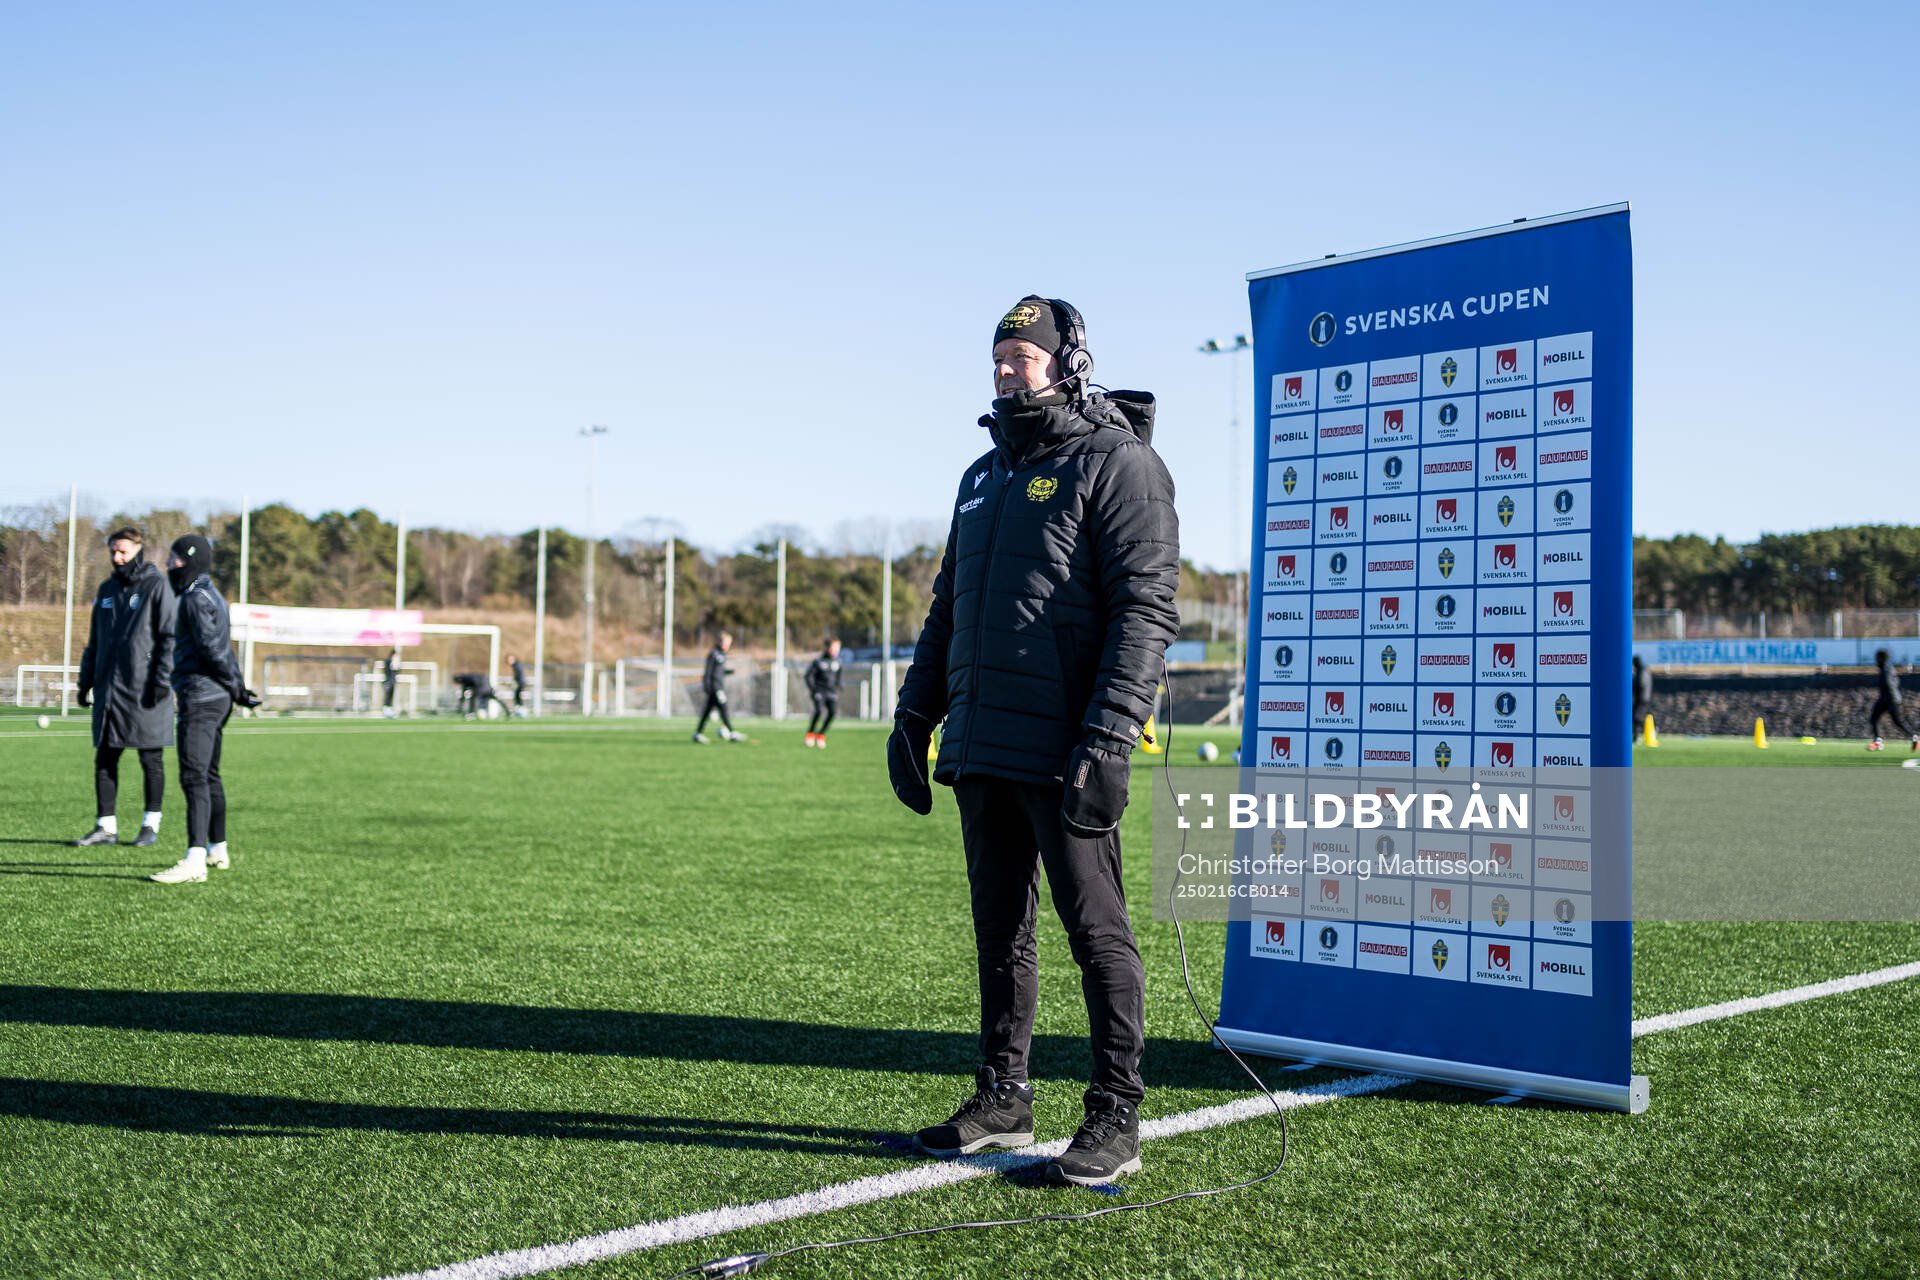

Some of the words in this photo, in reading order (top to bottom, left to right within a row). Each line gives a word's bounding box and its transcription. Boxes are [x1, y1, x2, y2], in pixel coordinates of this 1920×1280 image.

[1345, 300, 1455, 336] SVENSKA
[1462, 285, 1550, 318] CUPEN
[1544, 351, 1584, 366] MOBILL
[1372, 372, 1417, 386] BAUHAUS
[1486, 376, 1512, 384] SVENSKA
[1486, 409, 1527, 423] MOBILL
[1275, 431, 1308, 443] MOBILL
[1320, 425, 1363, 438] BAUHAUS
[1540, 450, 1588, 464] BAUHAUS
[1424, 461, 1472, 474] BAUHAUS
[1323, 471, 1358, 483] MOBILL
[1374, 513, 1411, 525] MOBILL
[1268, 520, 1309, 531] BAUHAUS
[1544, 552, 1583, 564] MOBILL
[1368, 560, 1413, 572] BAUHAUS
[1268, 612, 1303, 621] MOBILL
[1315, 609, 1359, 620] BAUHAUS
[1484, 606, 1526, 618] MOBILL
[1318, 656, 1354, 666] MOBILL
[1421, 655, 1469, 665] BAUHAUS
[1540, 654, 1587, 664] BAUHAUS
[1261, 702, 1304, 711] BAUHAUS
[1370, 703, 1408, 713] MOBILL
[1364, 750, 1410, 761] BAUHAUS
[1544, 756, 1583, 766] MOBILL
[1313, 842, 1350, 853] MOBILL
[1538, 858, 1588, 872] BAUHAUS
[1365, 894, 1405, 905] MOBILL
[1420, 915, 1446, 923] SVENSKA
[1282, 948, 1294, 956] SPEL
[1360, 942, 1407, 956] BAUHAUS
[1541, 962, 1585, 975] MOBILL
[1477, 972, 1505, 980] SVENSKA
